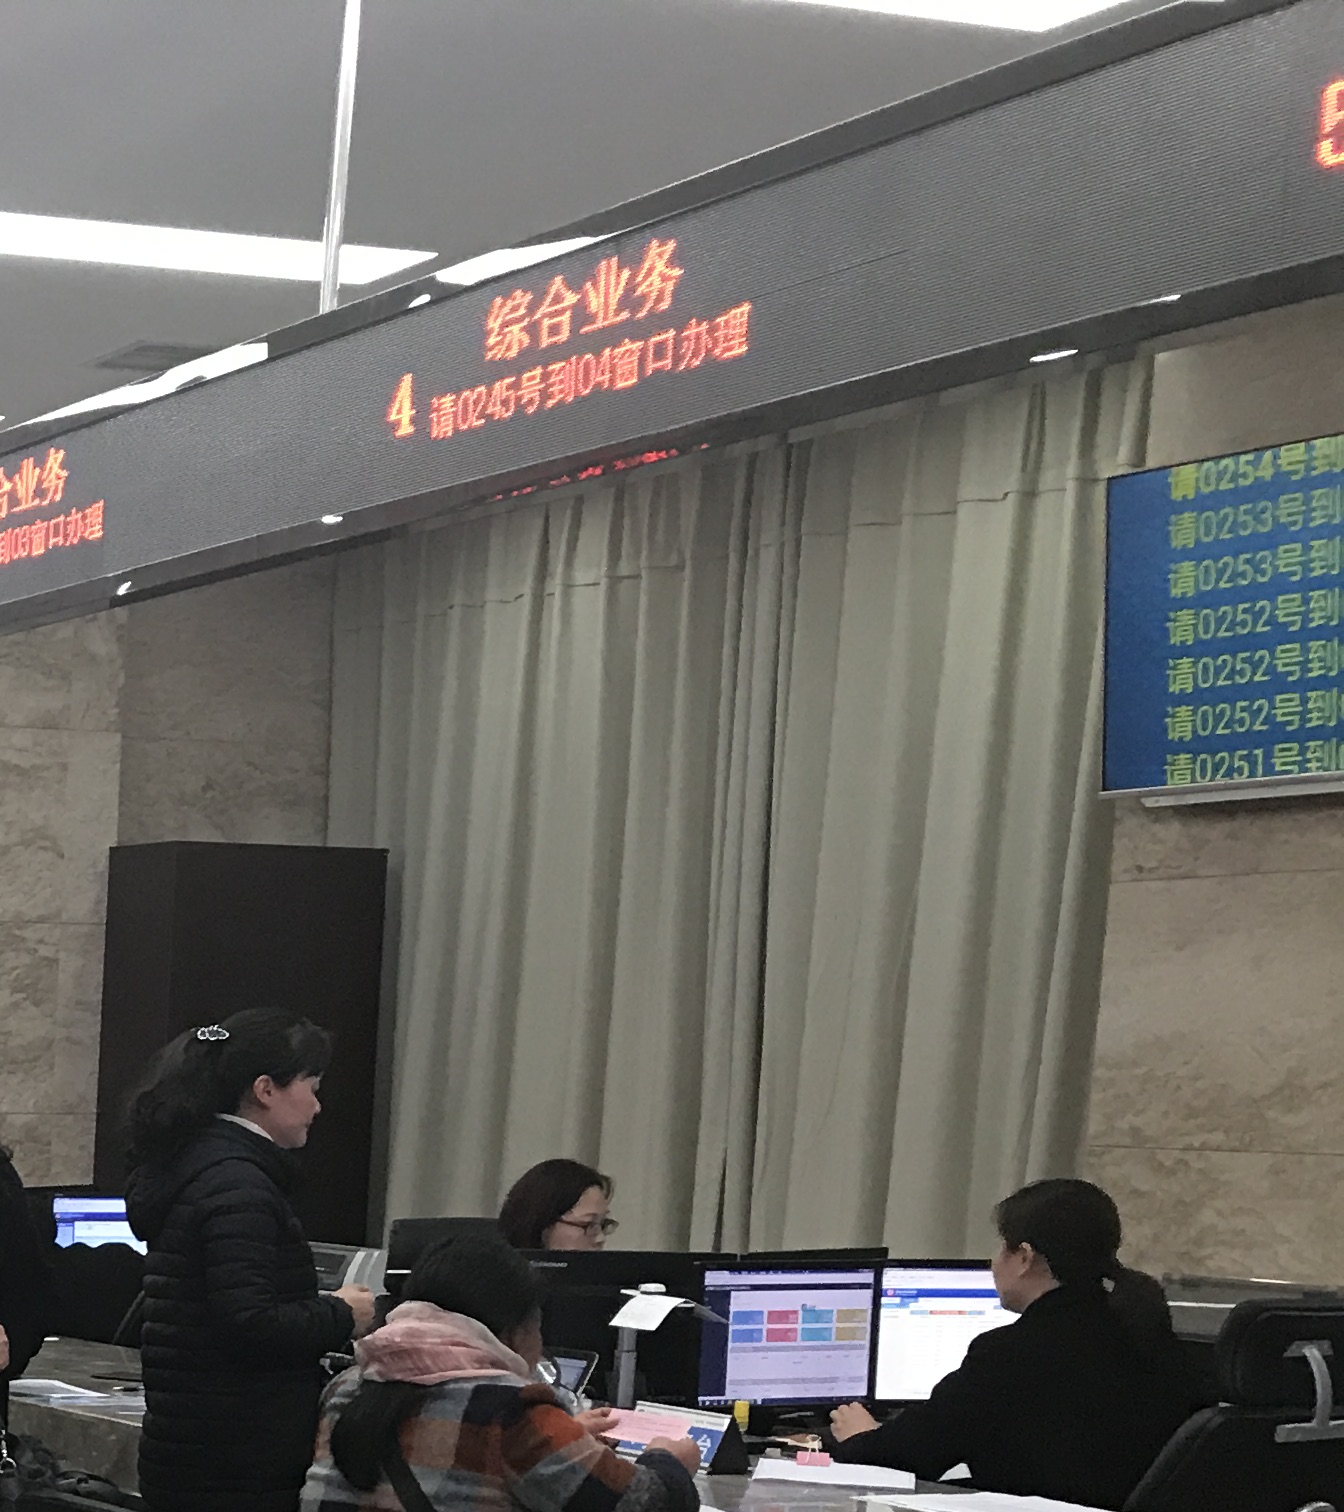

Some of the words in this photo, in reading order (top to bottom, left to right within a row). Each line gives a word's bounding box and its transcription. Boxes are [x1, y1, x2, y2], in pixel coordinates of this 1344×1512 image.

[483, 236, 684, 363] 综合业务
[386, 373, 416, 438] 4
[428, 301, 752, 440] 请0245号到04窗口办理
[1165, 637, 1344, 695] 请0252号到
[1163, 687, 1344, 743] 请0252号到
[1163, 737, 1344, 787] 请0251号到
